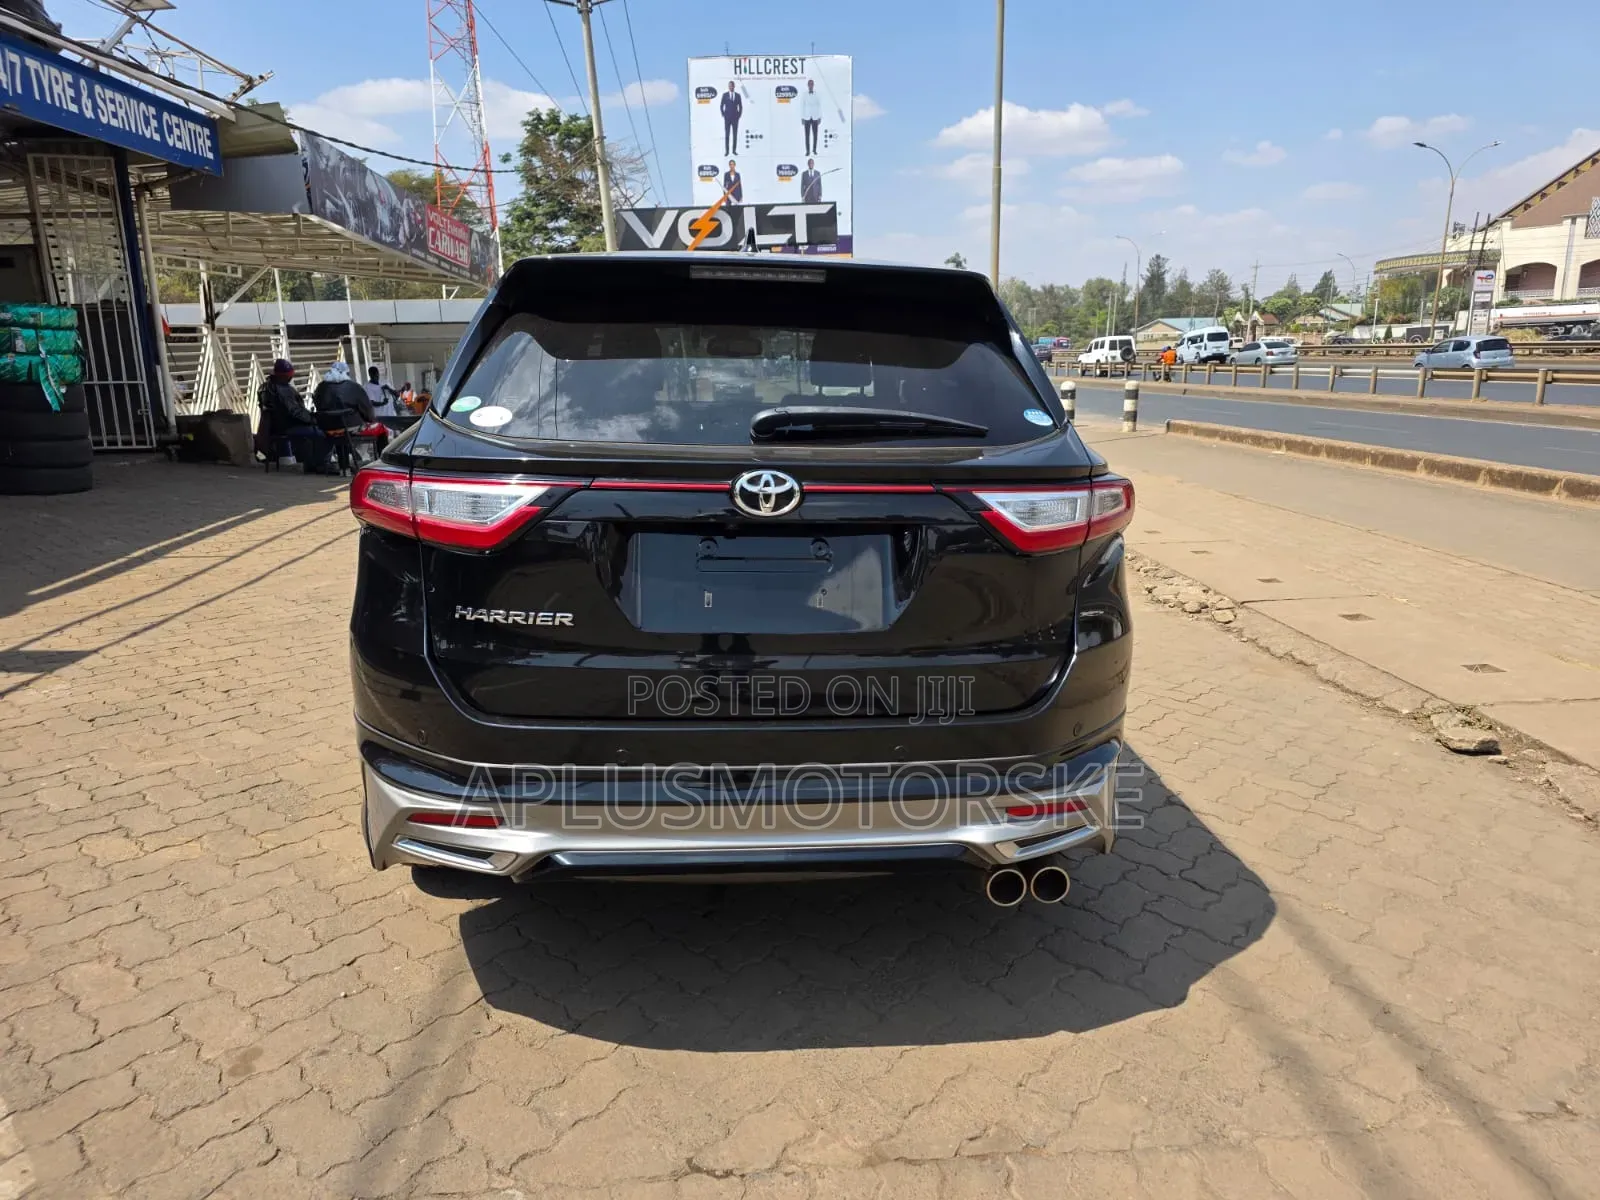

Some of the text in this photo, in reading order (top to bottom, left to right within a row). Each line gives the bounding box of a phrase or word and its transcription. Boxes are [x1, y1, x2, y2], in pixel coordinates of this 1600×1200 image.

[734, 57, 806, 75] HILLCREST
[24, 57, 79, 114] TYRE
[80, 78, 95, 119] &
[94, 84, 161, 142] SERVICE
[162, 112, 214, 160] CENTRE
[619, 203, 835, 249] VOLT
[429, 227, 469, 265] CARWASH
[454, 605, 574, 626] HARRIER
